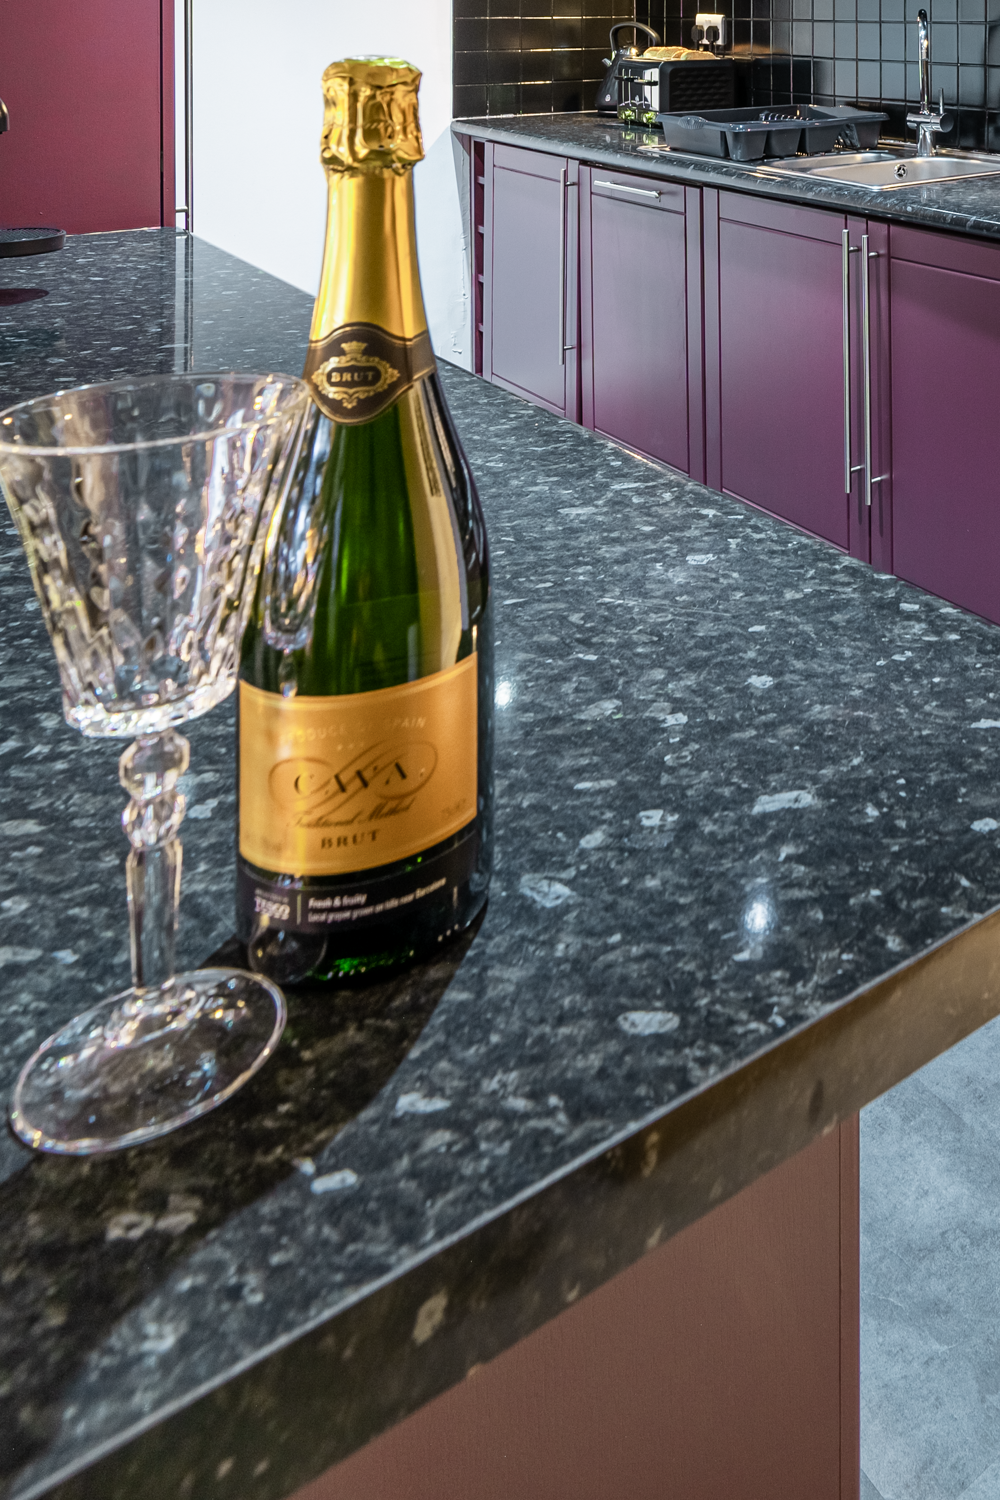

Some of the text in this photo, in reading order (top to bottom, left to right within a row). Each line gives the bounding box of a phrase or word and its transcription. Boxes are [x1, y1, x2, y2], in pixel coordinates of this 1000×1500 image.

[331, 371, 376, 383] BRUT
[321, 828, 380, 850] BRUT
[308, 896, 333, 909] Fresh
[342, 893, 367, 907] fruity
